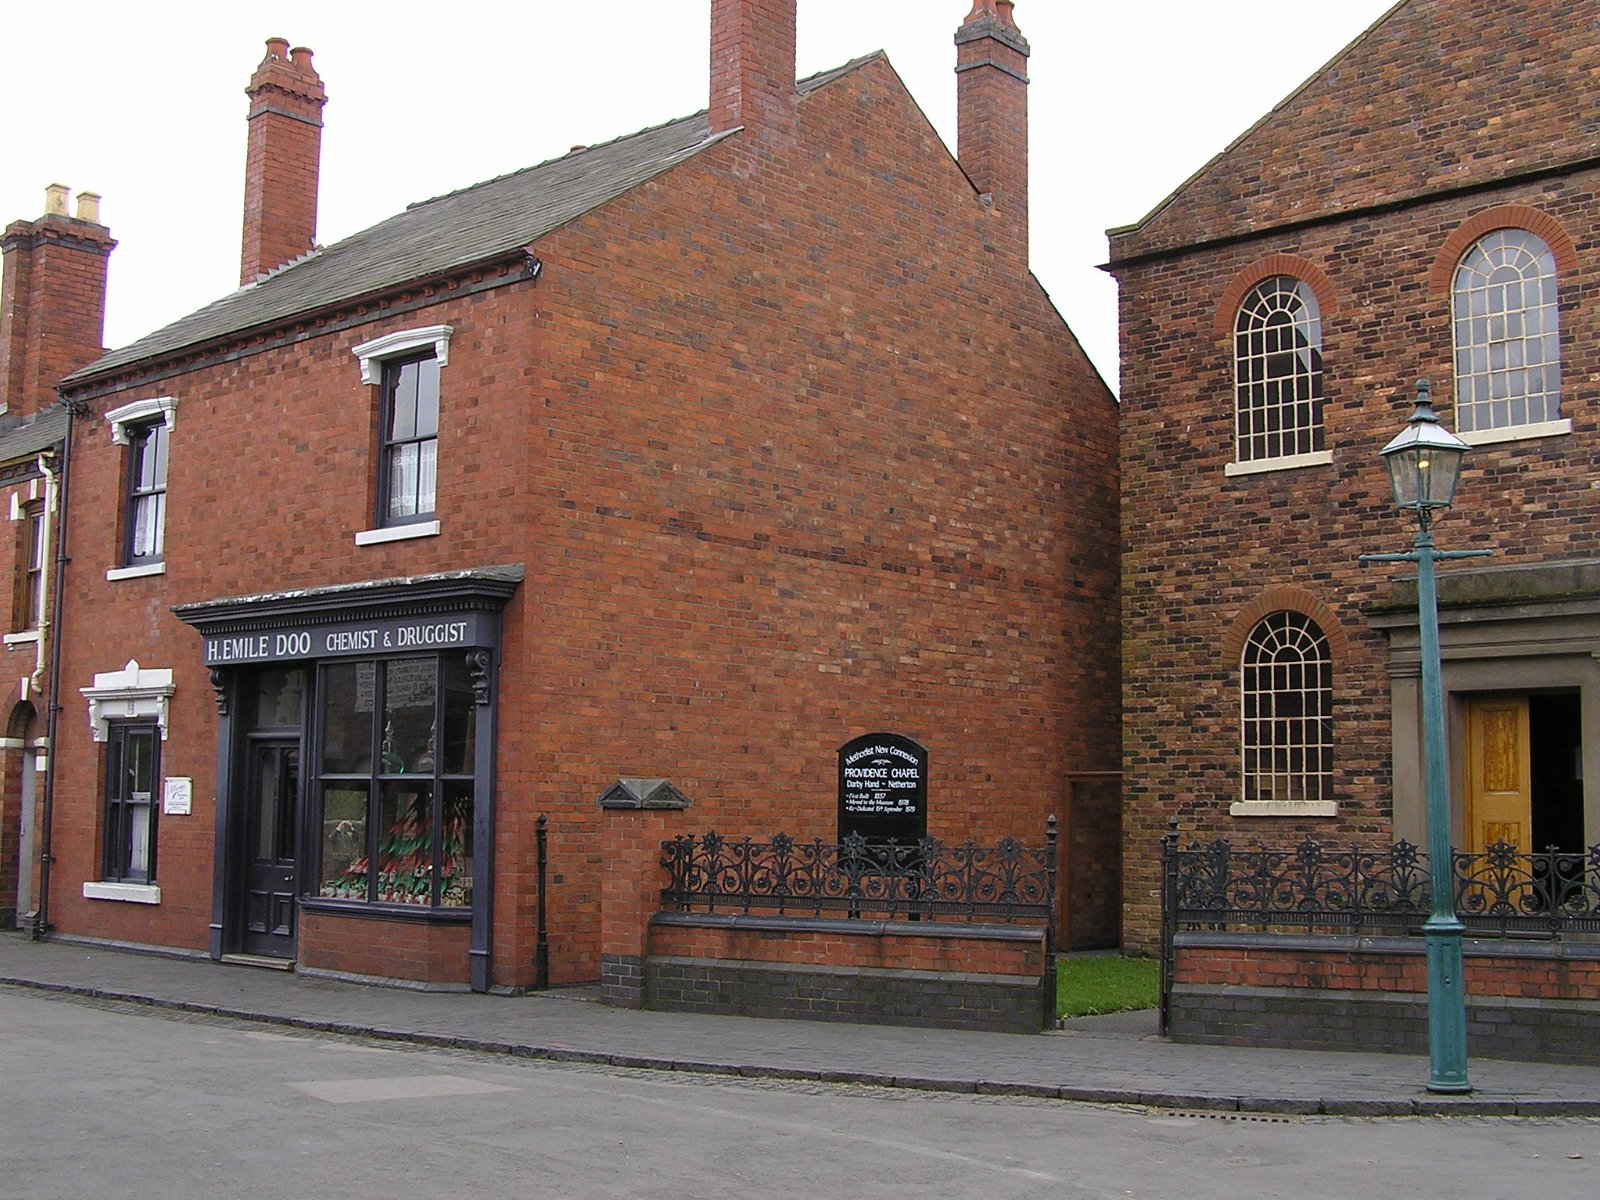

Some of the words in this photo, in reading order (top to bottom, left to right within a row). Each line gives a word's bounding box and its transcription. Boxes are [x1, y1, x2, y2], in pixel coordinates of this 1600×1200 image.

[276, 631, 311, 656] DOO
[326, 629, 378, 651] CHEMIST
[383, 631, 392, 647] &
[397, 622, 467, 646] DRUGGIST
[845, 746, 874, 766] Methodist
[875, 745, 888, 754] New
[889, 745, 919, 766] Connexion
[844, 768, 888, 778] PROVIDENCE
[891, 768, 920, 778] CHAPEL
[846, 780, 863, 790] Darby
[864, 780, 880, 788] Hand
[888, 780, 917, 788] Netherton
